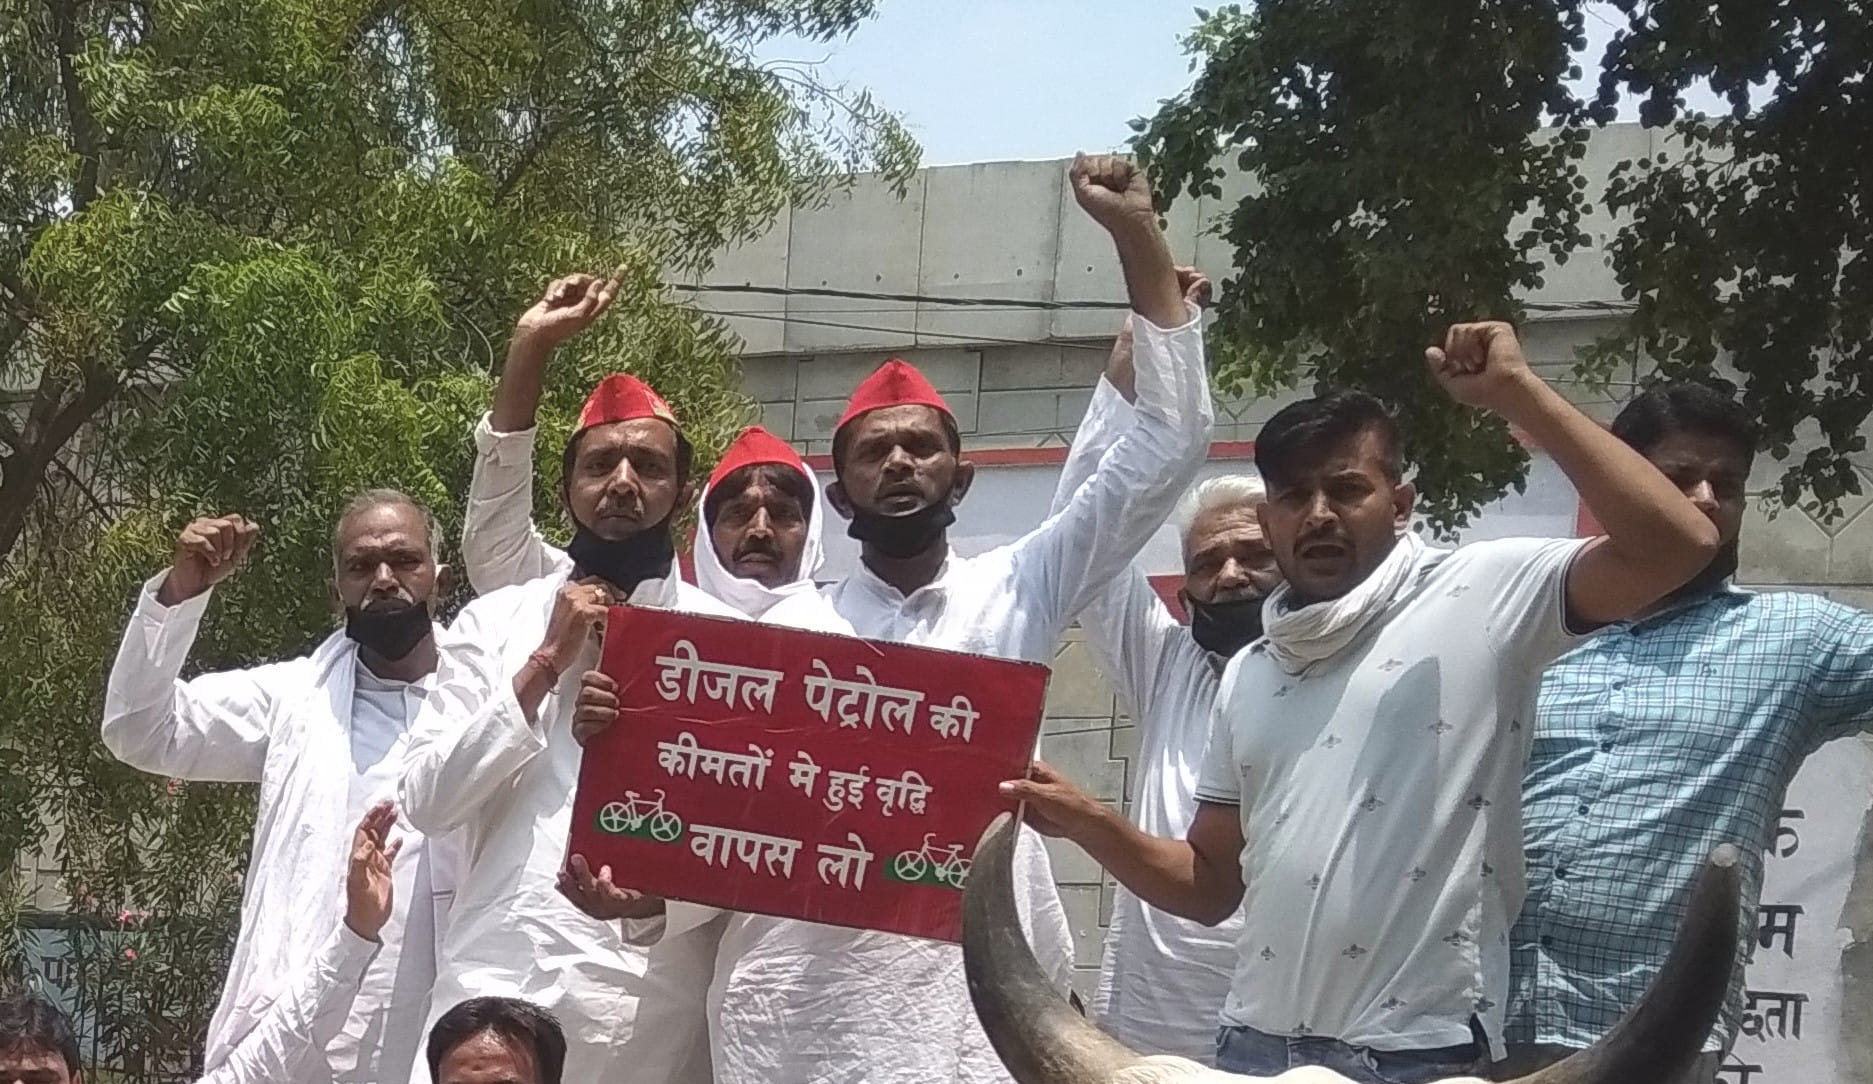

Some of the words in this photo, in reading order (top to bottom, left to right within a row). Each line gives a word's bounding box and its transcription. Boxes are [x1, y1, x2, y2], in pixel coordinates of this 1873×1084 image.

[654, 640, 784, 714] डीजल
[804, 659, 924, 735] पेट्रोल
[929, 695, 979, 743] की
[657, 732, 773, 790] कीमतों
[789, 751, 821, 797] मे
[822, 766, 870, 811] हुई
[689, 823, 802, 880] वापस
[817, 833, 874, 891] लो
